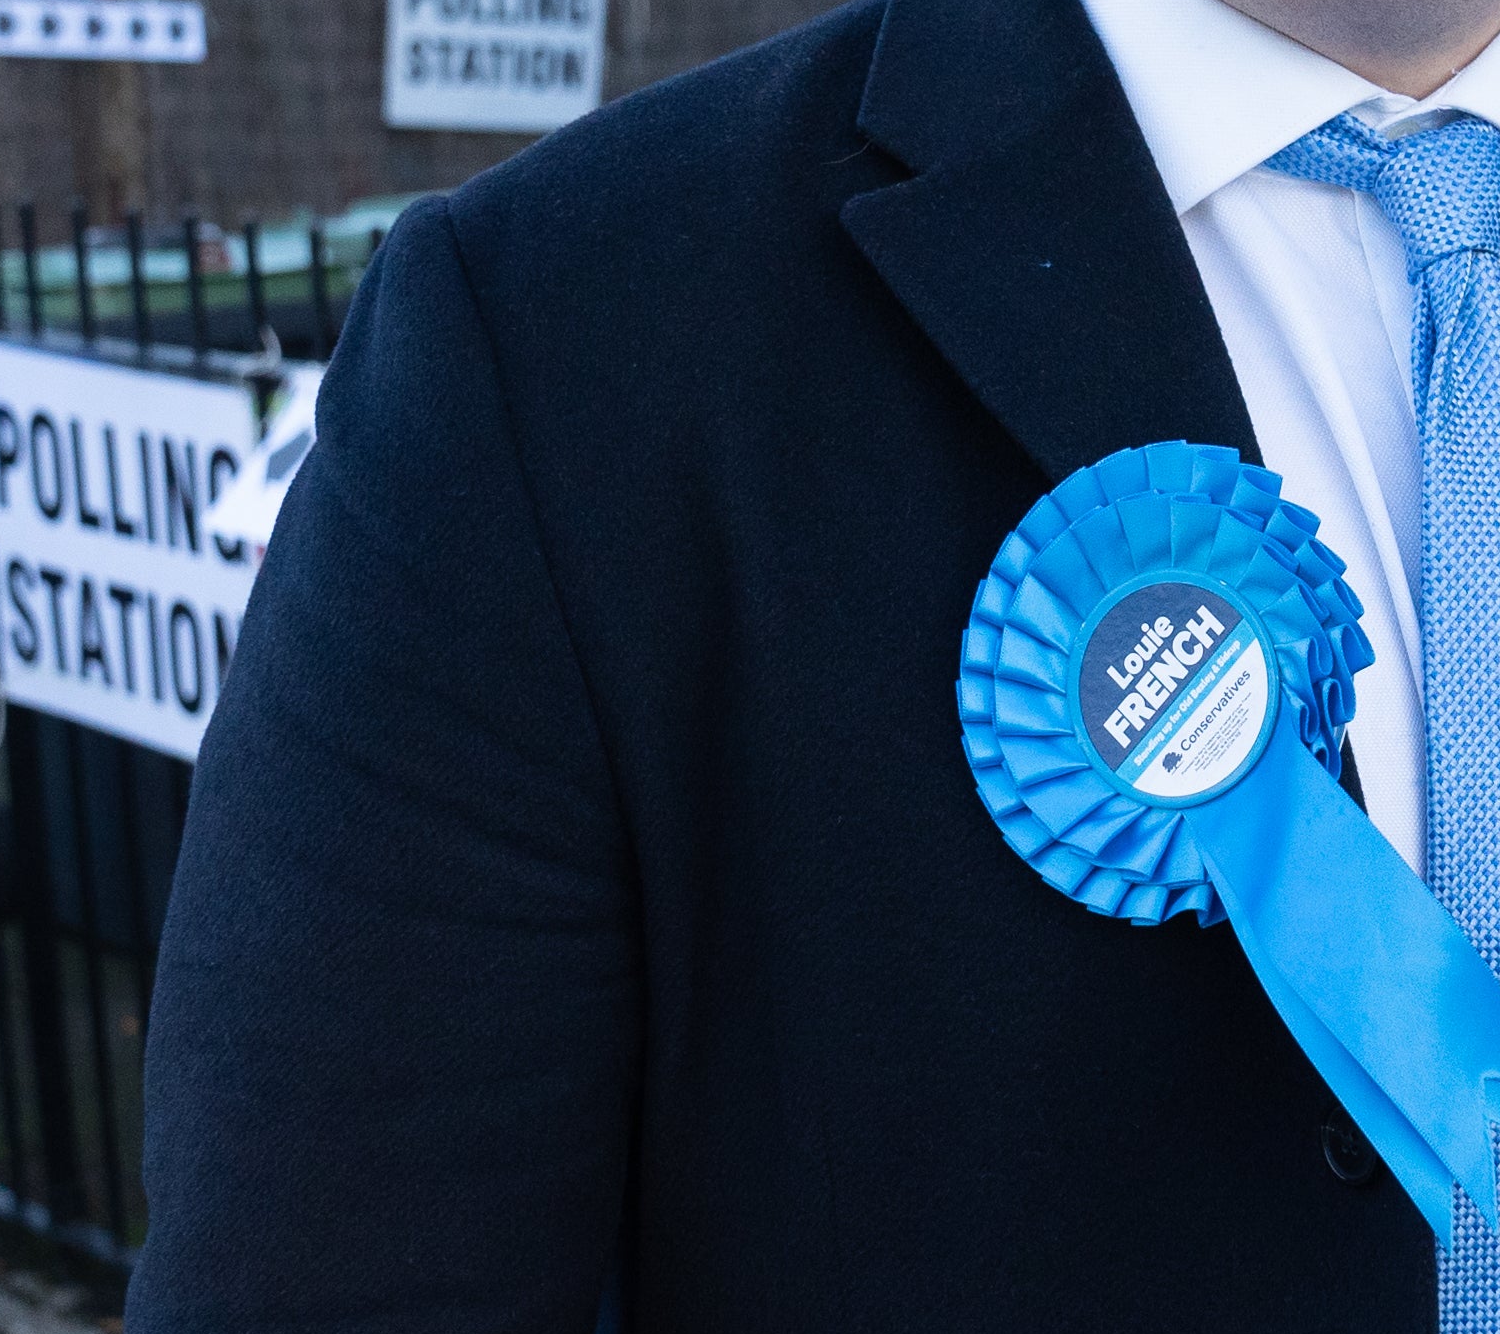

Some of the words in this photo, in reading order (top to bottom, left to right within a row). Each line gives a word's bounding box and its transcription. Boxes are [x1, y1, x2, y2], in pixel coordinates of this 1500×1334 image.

[1103, 604, 1226, 749] FRENCH
[1106, 615, 1174, 690] Louie
[1180, 670, 1251, 751] Conservatives
